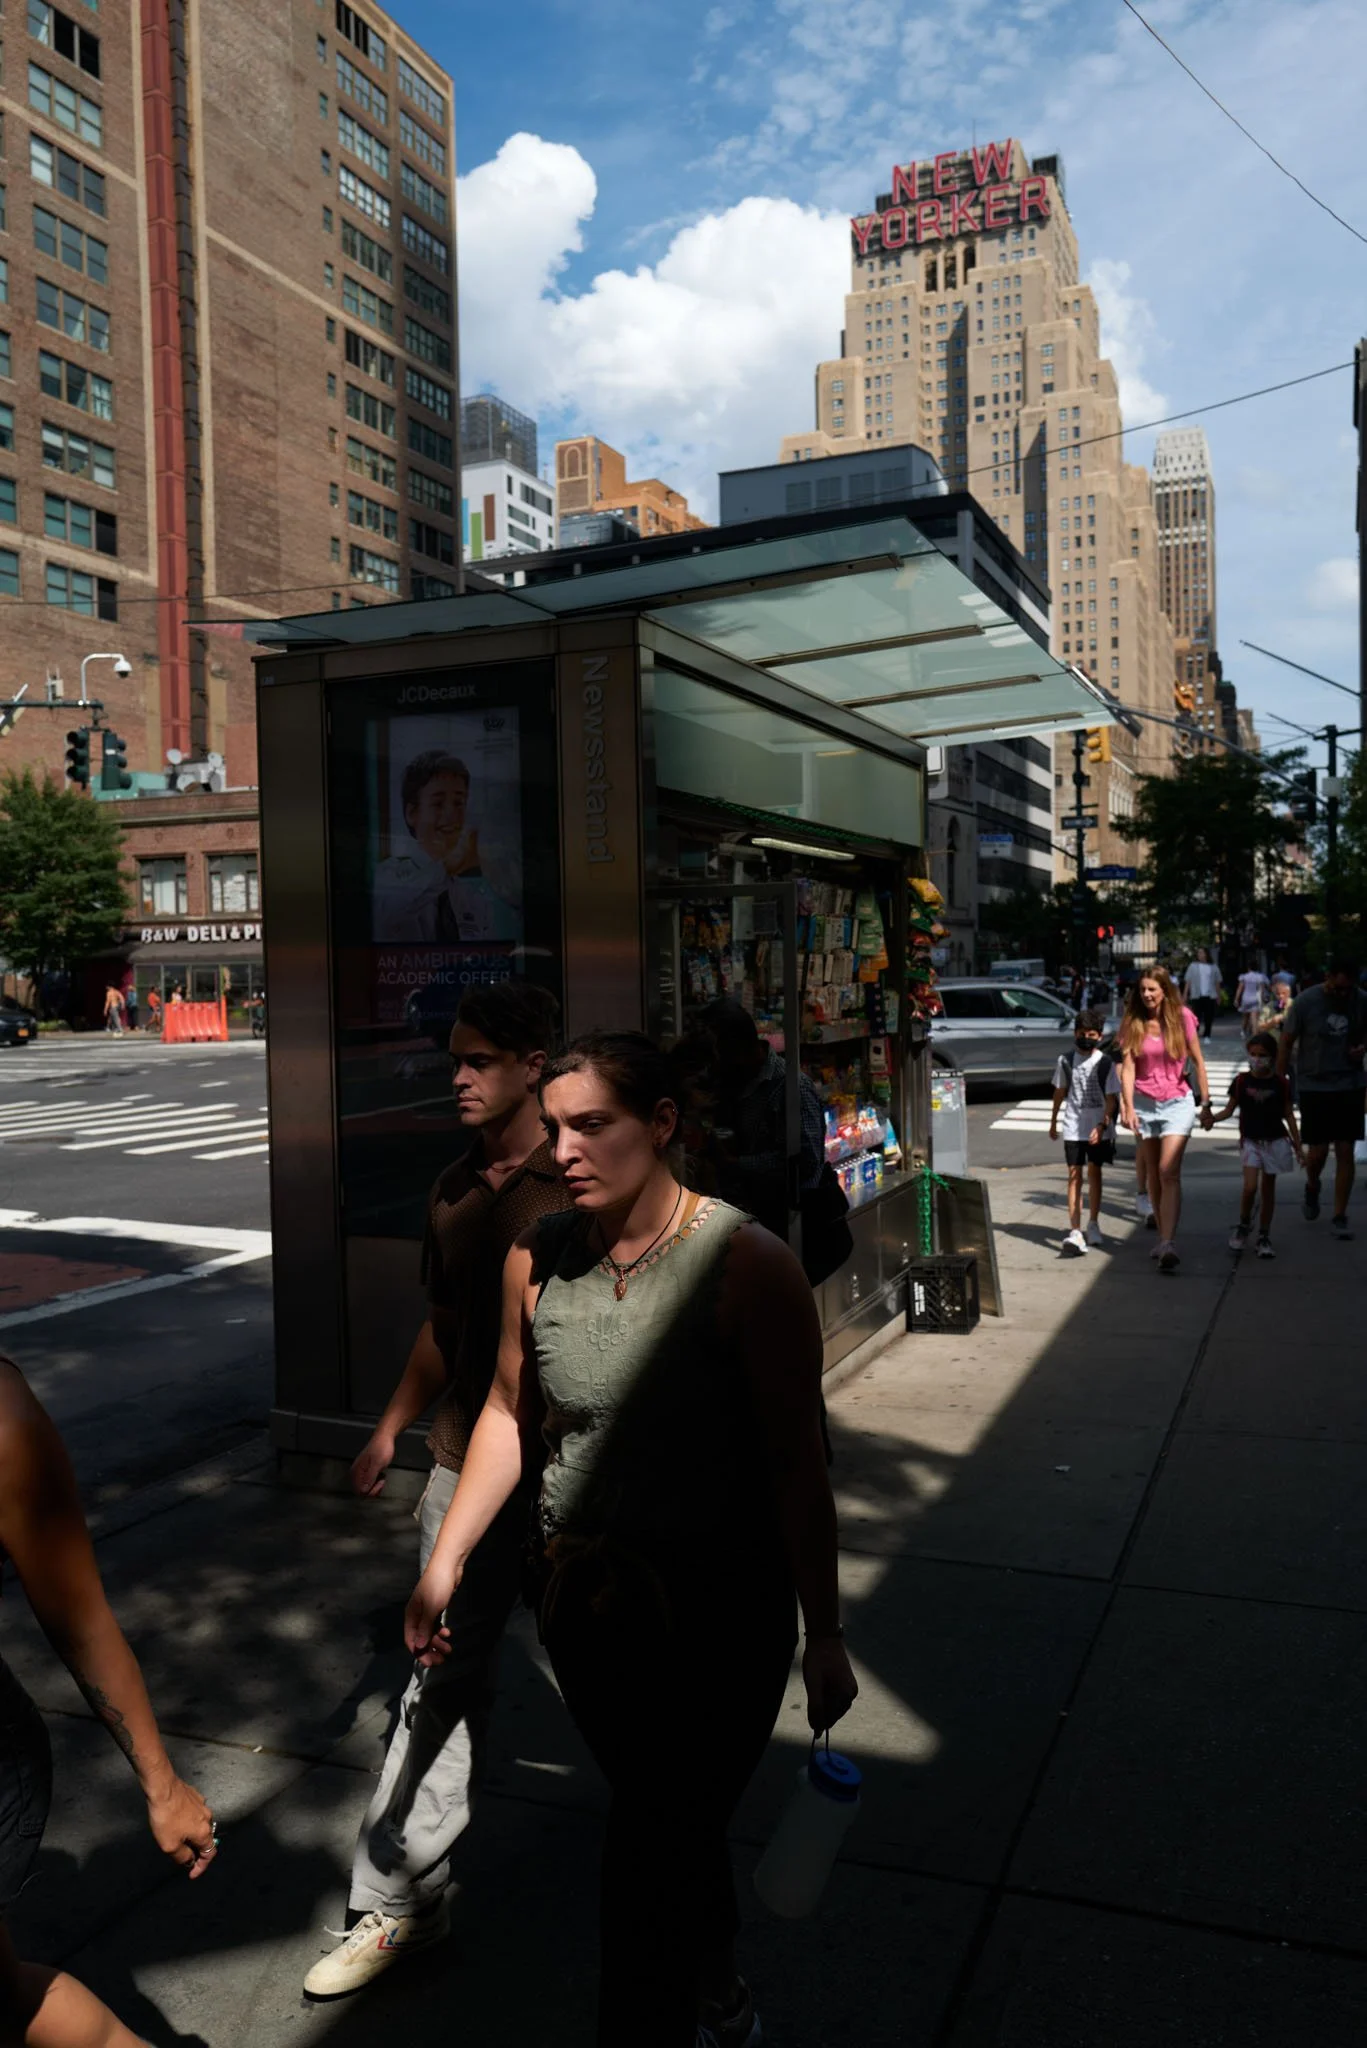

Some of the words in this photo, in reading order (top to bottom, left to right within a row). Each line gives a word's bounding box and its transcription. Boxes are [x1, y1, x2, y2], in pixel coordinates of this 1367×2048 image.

[892, 137, 1012, 205] NEW
[851, 175, 1051, 255] YORKER
[397, 683, 477, 704] JCDecaux
[581, 656, 615, 863] Newsstand
[141, 928, 179, 943] B&W
[187, 925, 227, 942] DELI
[230, 925, 241, 941] &
[377, 955, 398, 969] AN
[401, 951, 510, 969] AMBITIOUS
[377, 971, 456, 985] ACADEMIC
